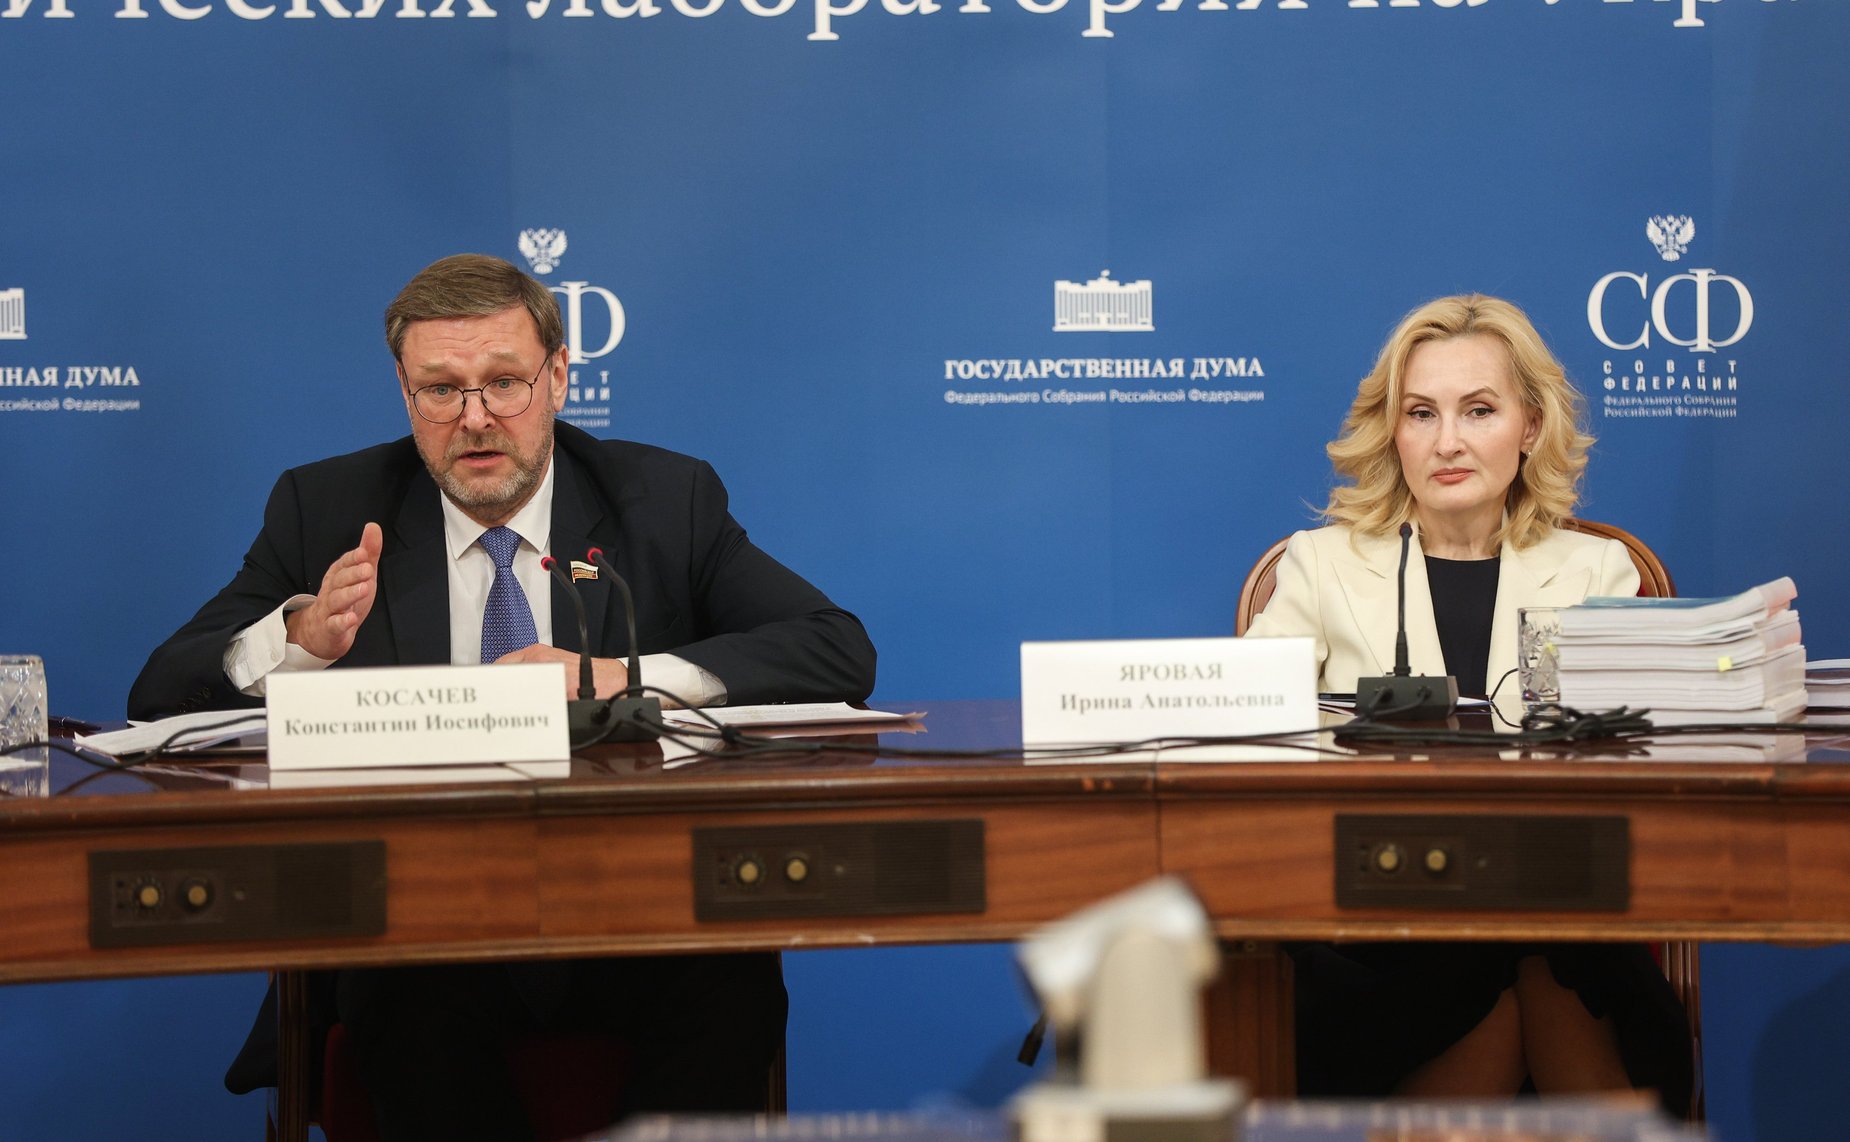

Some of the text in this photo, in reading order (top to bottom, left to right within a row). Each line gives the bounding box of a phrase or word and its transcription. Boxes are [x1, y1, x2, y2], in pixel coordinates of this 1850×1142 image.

[1587, 268, 1754, 353] СФ
[548, 281, 626, 365] Ф
[944, 357, 1265, 381] ГОСУДАРСТВЕННАЯ ДУМА
[1603, 359, 1737, 374] СОВЕТ
[64, 366, 140, 389] ДУМА
[1603, 376, 1737, 392] ФЕДЕРАЦИИ
[62, 397, 140, 412] Федерации
[944, 388, 1265, 405] Федерального Собрания Российской Федерации
[1120, 663, 1223, 682] ЯРОВАЯ
[356, 687, 477, 707] КОСАЧЕВ
[1061, 692, 1286, 715] Ирина Анатольевна
[285, 713, 550, 736] Константин Иосифович
